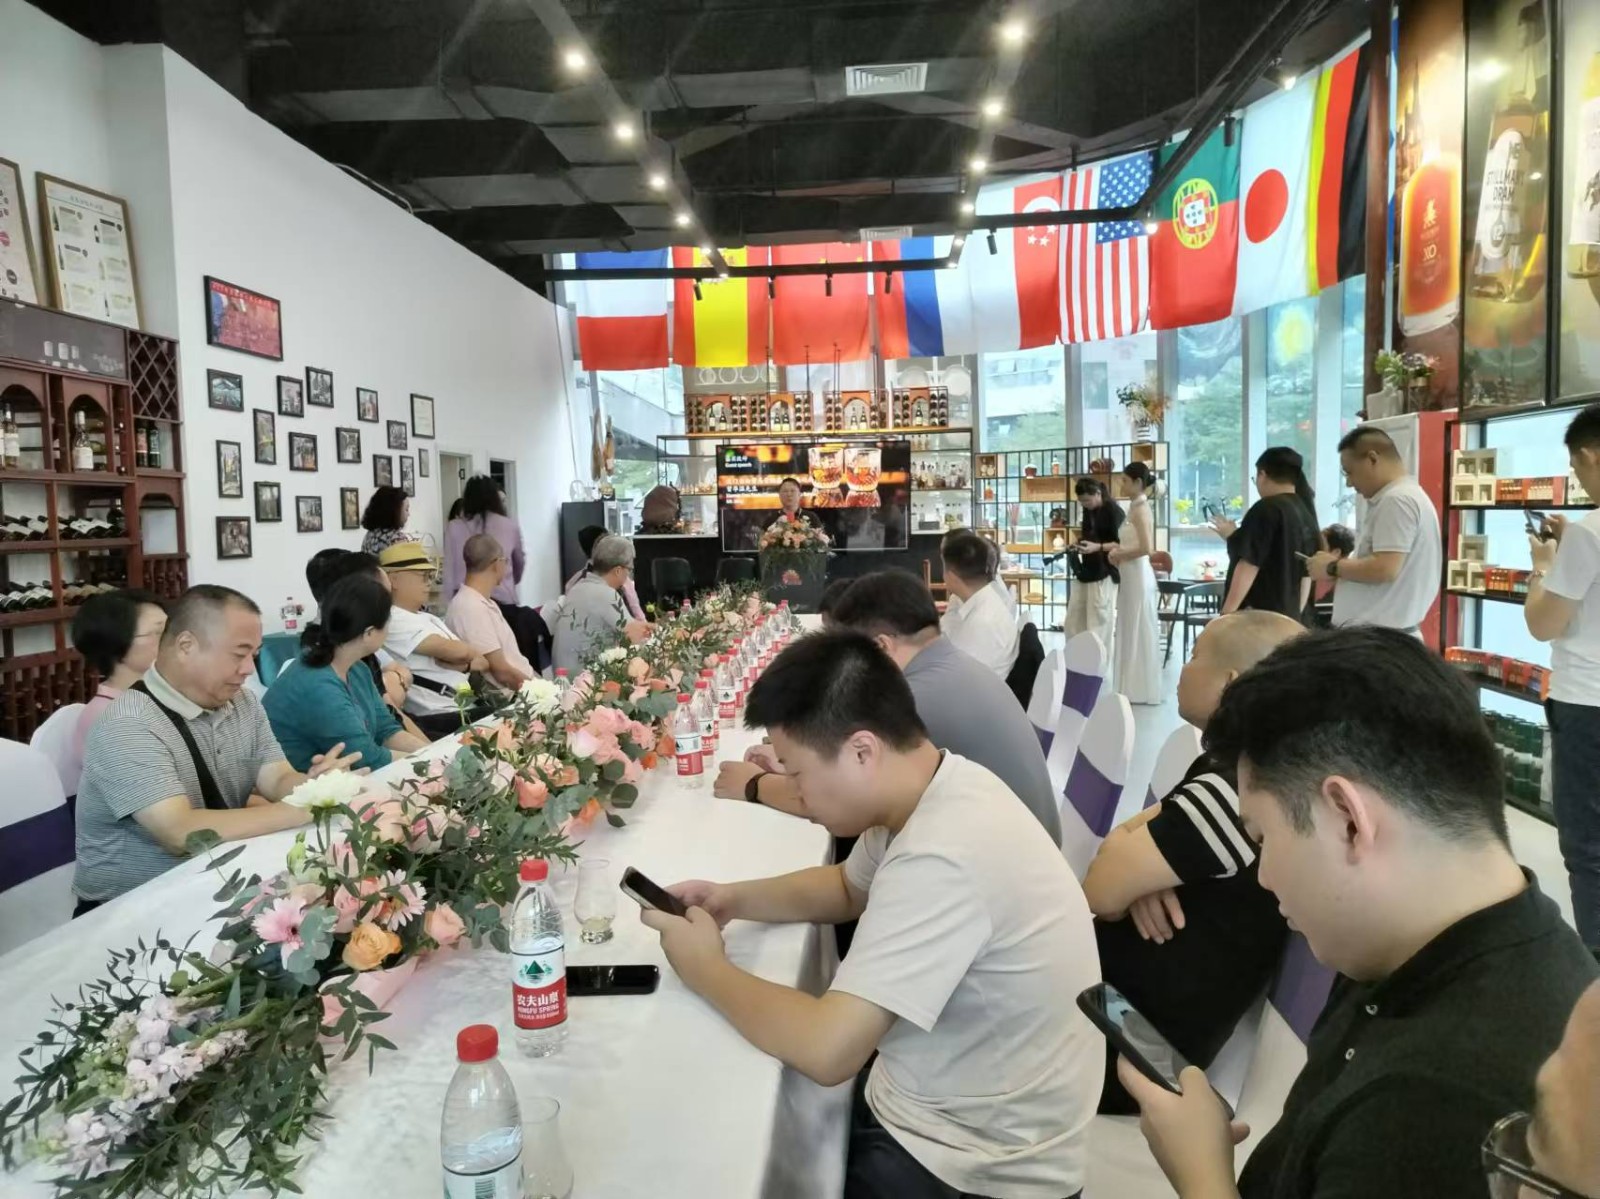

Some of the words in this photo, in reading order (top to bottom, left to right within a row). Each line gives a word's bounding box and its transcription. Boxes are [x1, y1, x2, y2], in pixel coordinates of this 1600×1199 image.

[517, 991, 559, 1007] 农夫山泉
[539, 1003, 560, 1013] SPRING
